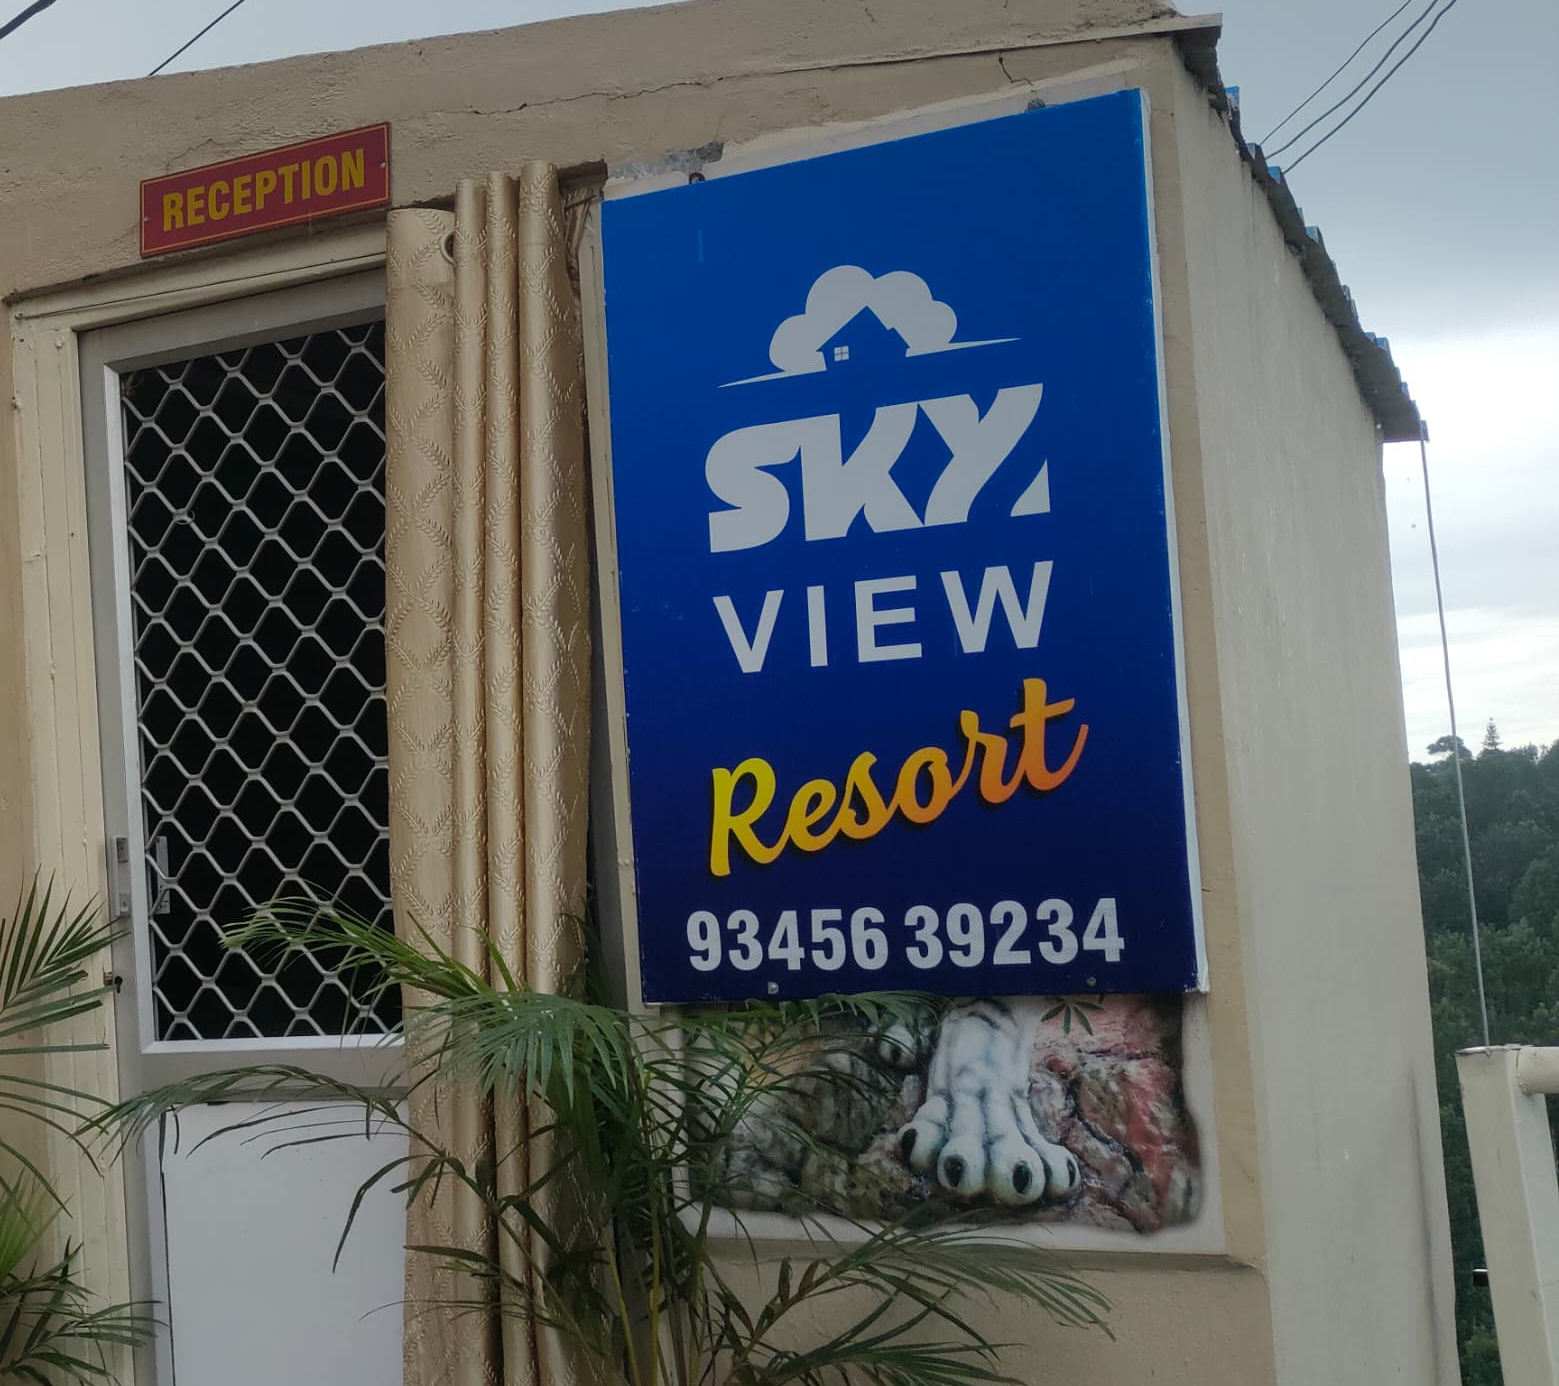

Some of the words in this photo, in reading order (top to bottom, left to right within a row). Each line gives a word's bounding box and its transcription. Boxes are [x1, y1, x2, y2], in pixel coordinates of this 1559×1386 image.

[162, 148, 365, 232] RECEPTION
[704, 382, 1051, 554] SKY
[712, 560, 1055, 675] VIEW
[709, 677, 1090, 878] Resort
[685, 905, 890, 973] 93456
[904, 897, 1125, 969] 39234
